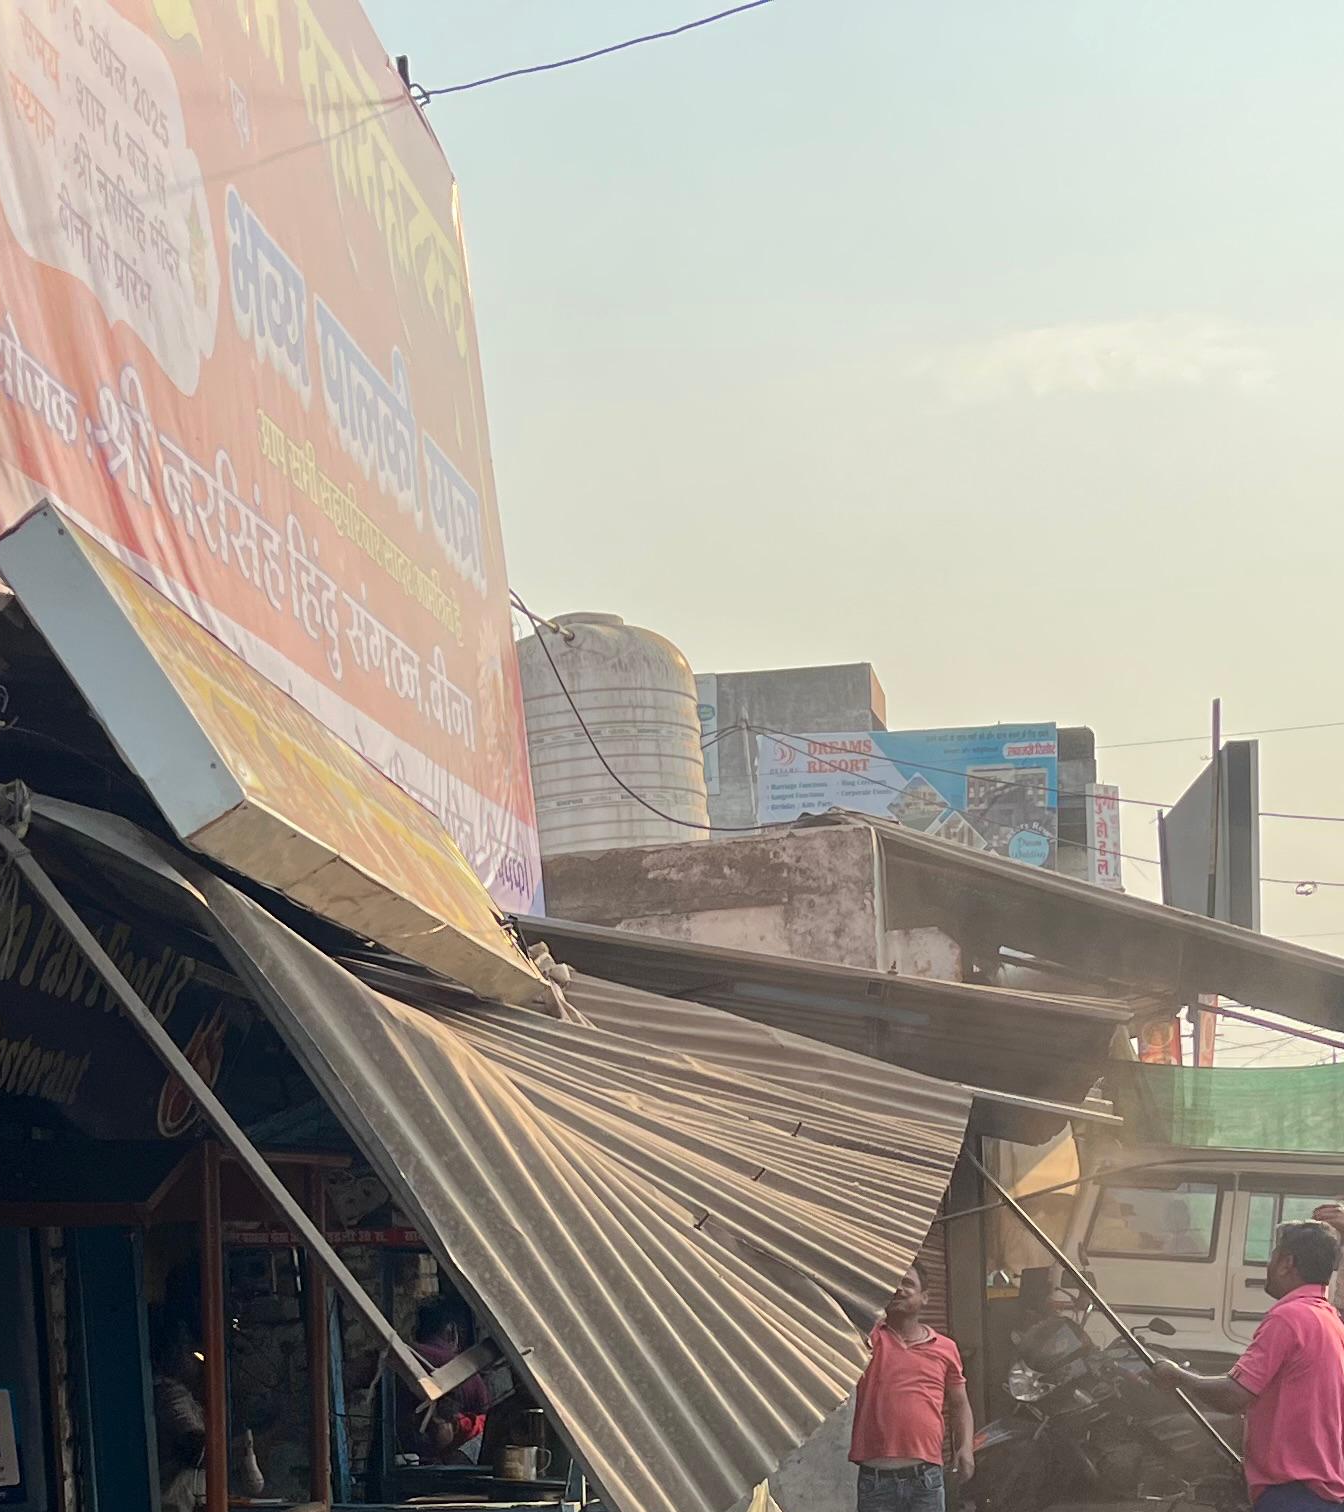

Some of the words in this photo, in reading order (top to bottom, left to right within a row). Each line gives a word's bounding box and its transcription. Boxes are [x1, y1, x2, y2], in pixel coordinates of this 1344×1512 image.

[131, 76, 169, 149] 2025
[225, 184, 312, 410] भव्य
[314, 294, 424, 532] पालकी
[423, 430, 488, 598] यात्रा
[99, 365, 153, 506] श्री
[158, 448, 286, 608] नरसिंह
[427, 645, 478, 753] बीना
[807, 739, 872, 756] DREAMS
[807, 758, 870, 774] RESORT
